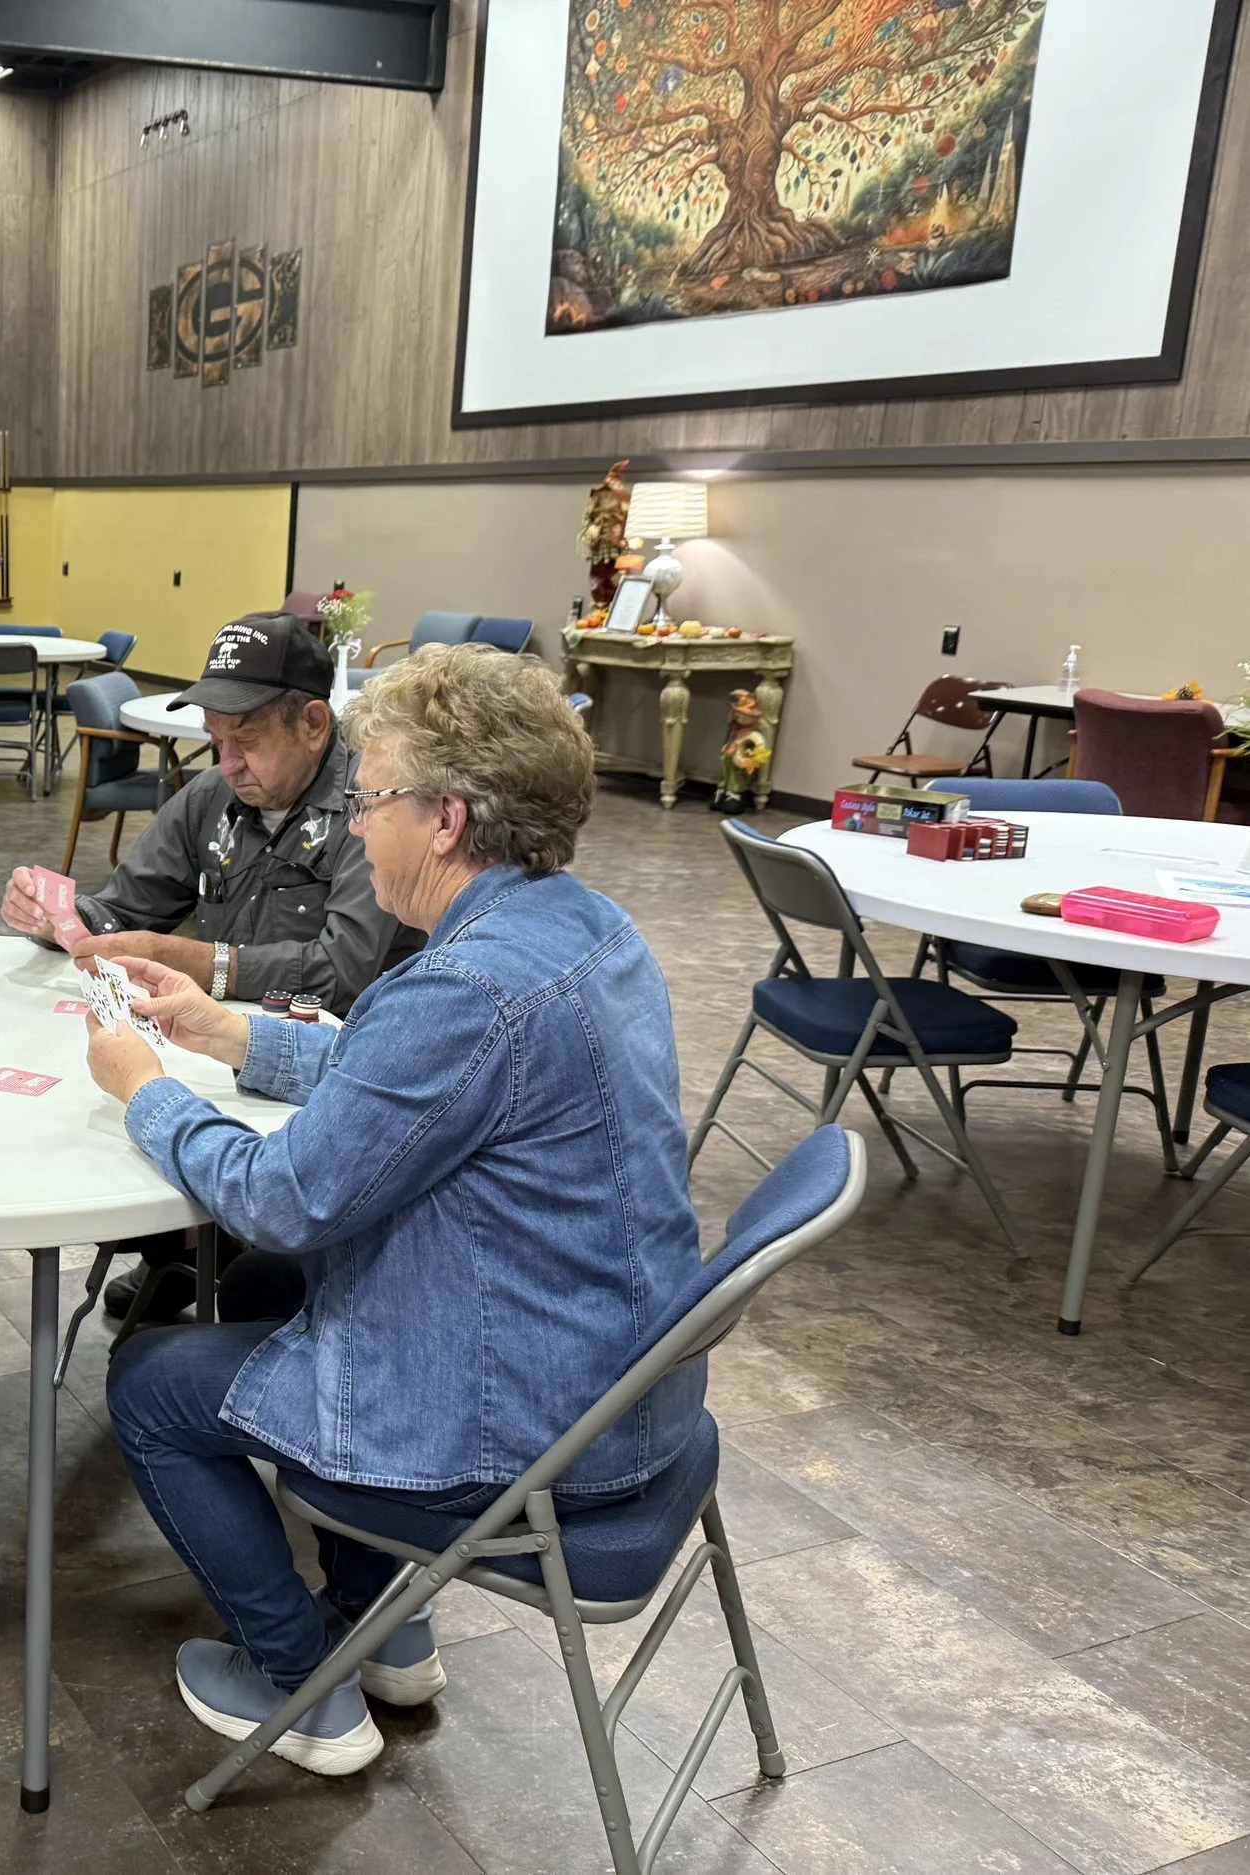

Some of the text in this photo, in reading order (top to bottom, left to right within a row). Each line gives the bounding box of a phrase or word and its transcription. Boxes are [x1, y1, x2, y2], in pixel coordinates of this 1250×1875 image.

[227, 634, 236, 642] OF
[236, 635, 251, 643] THE
[252, 630, 268, 645] INC.
